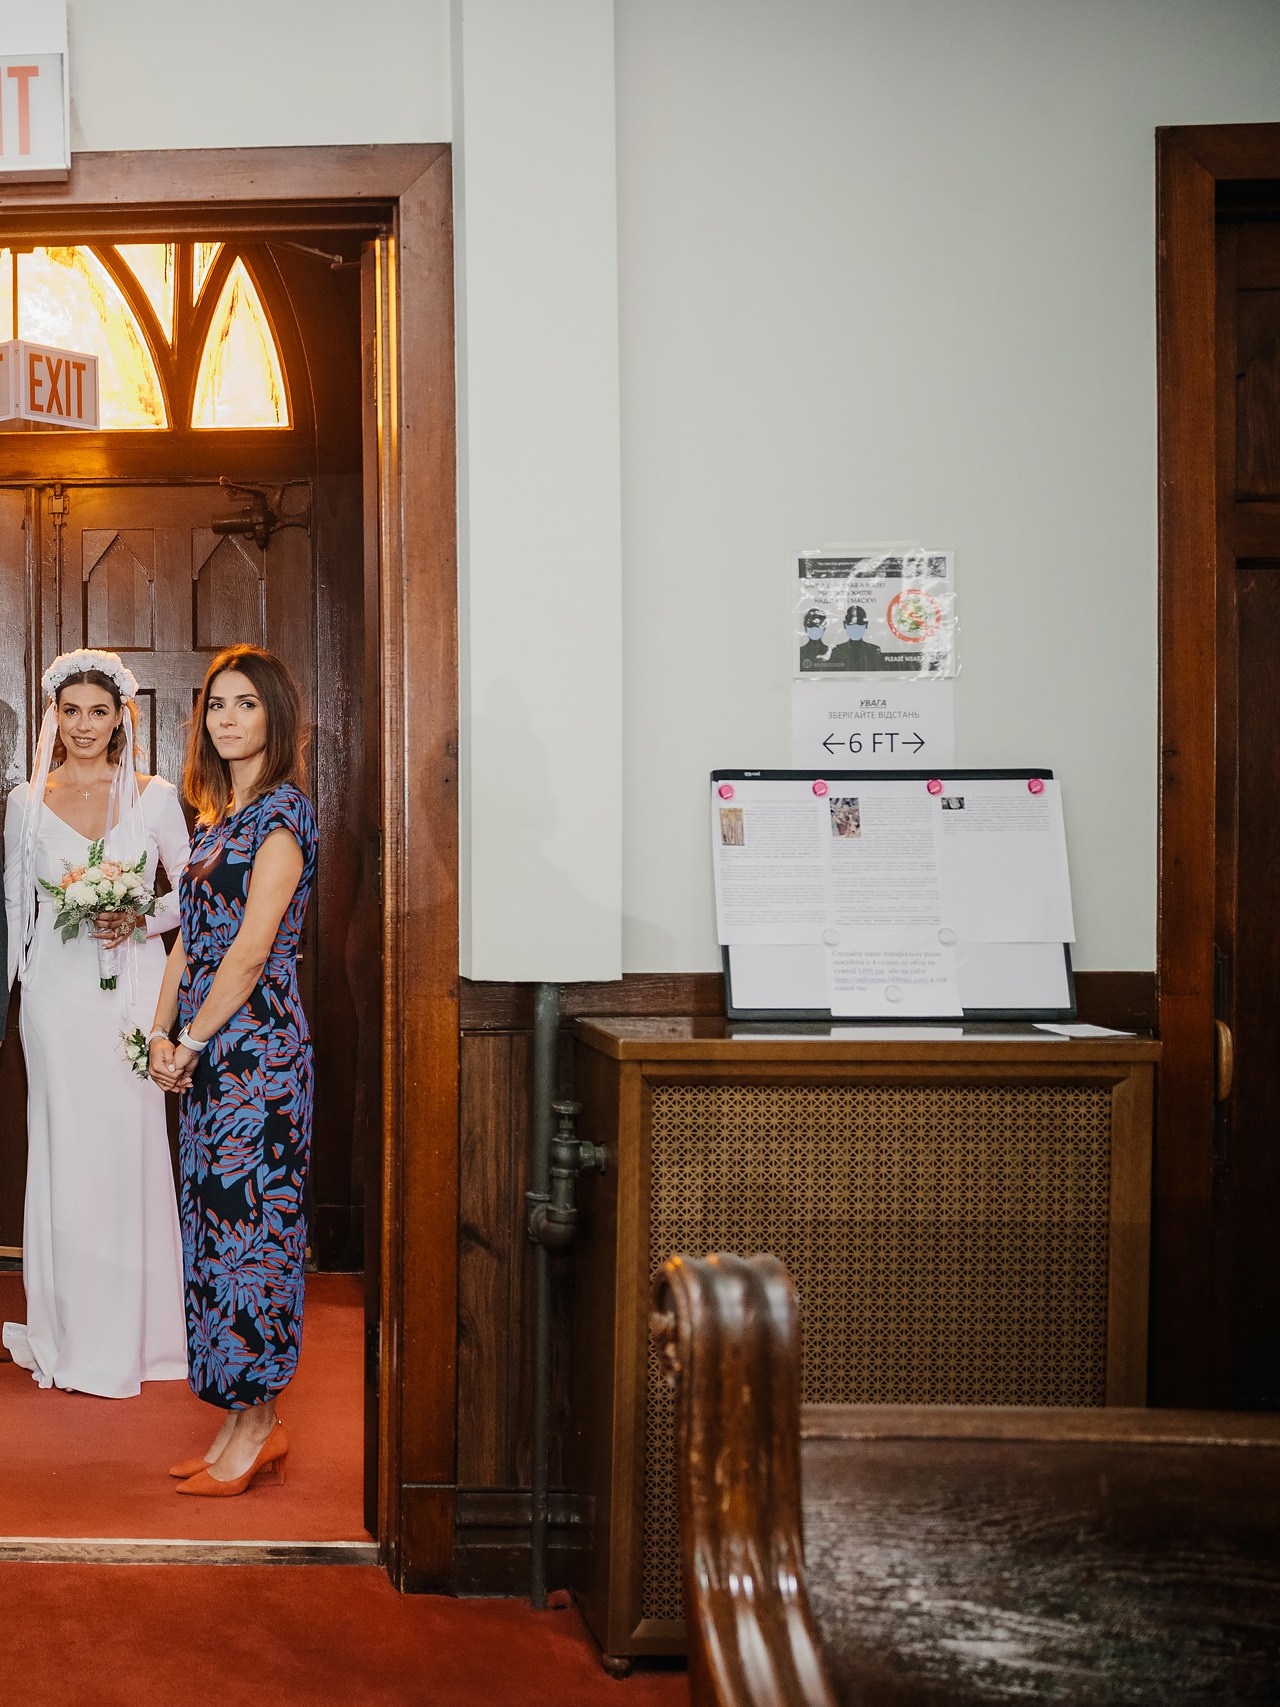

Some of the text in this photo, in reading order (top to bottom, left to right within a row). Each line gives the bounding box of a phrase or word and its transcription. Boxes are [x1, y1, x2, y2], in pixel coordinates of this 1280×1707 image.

[29, 353, 86, 419] EXIT
[859, 699, 887, 707] УВАГА
[828, 710, 920, 720] ЗБЕРІГАЙТЕ ВІДСТАНЬ
[849, 732, 899, 753] 6 FT
